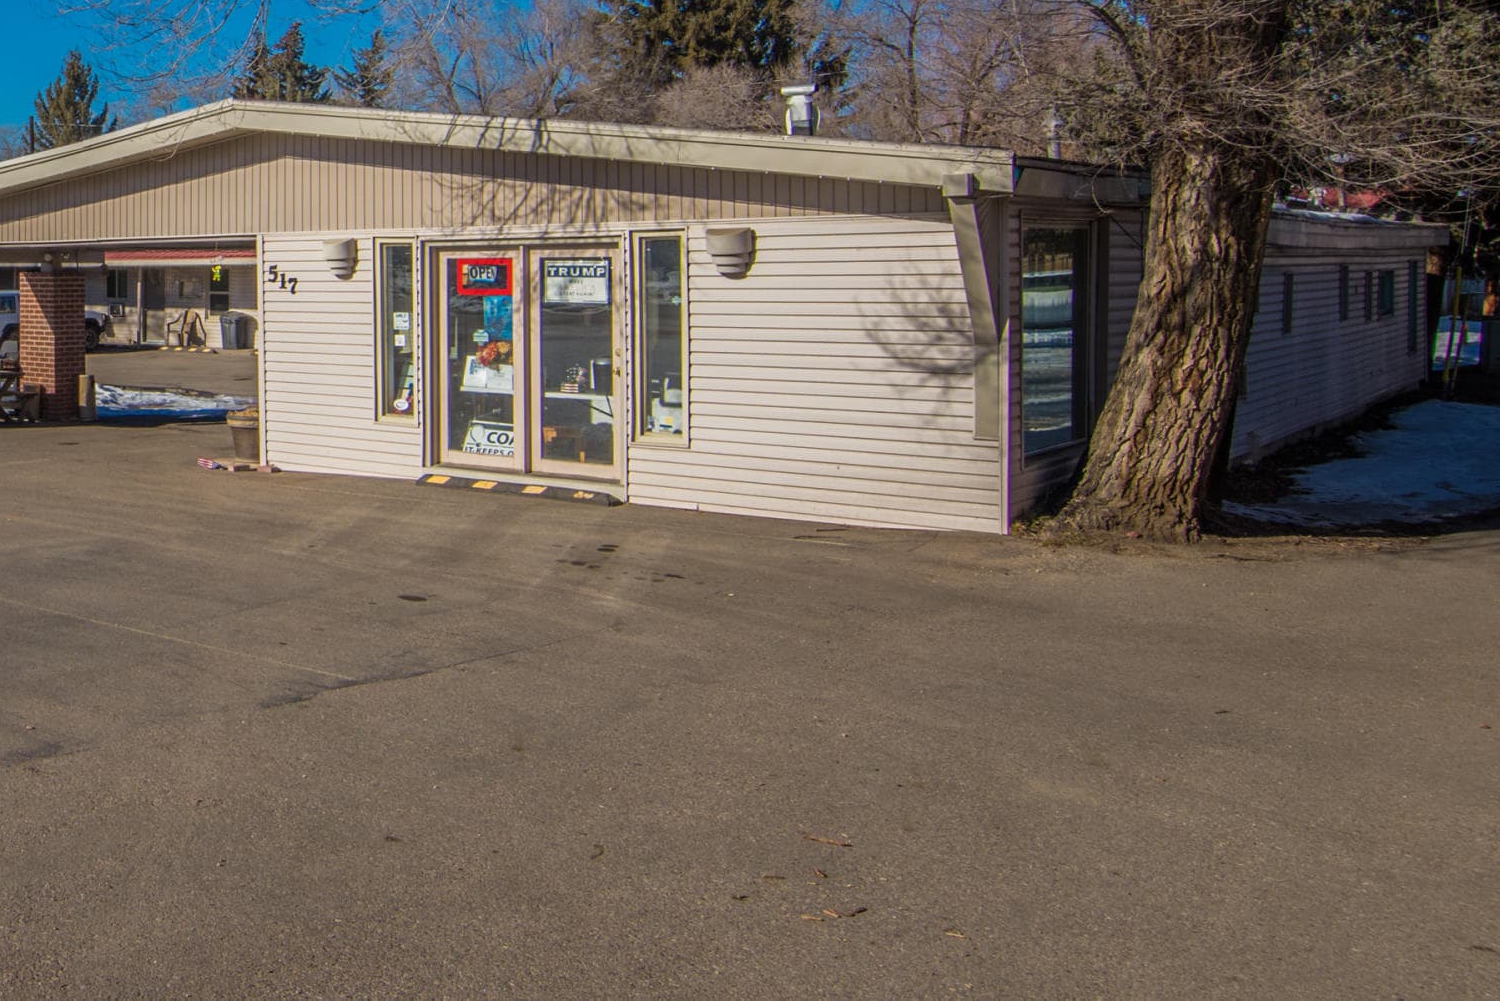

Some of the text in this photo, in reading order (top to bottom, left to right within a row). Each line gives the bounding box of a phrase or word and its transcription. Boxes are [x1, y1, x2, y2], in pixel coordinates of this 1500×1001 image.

[267, 264, 298, 294] 517
[469, 265, 498, 280] OPEN
[548, 266, 605, 277] TRUMP
